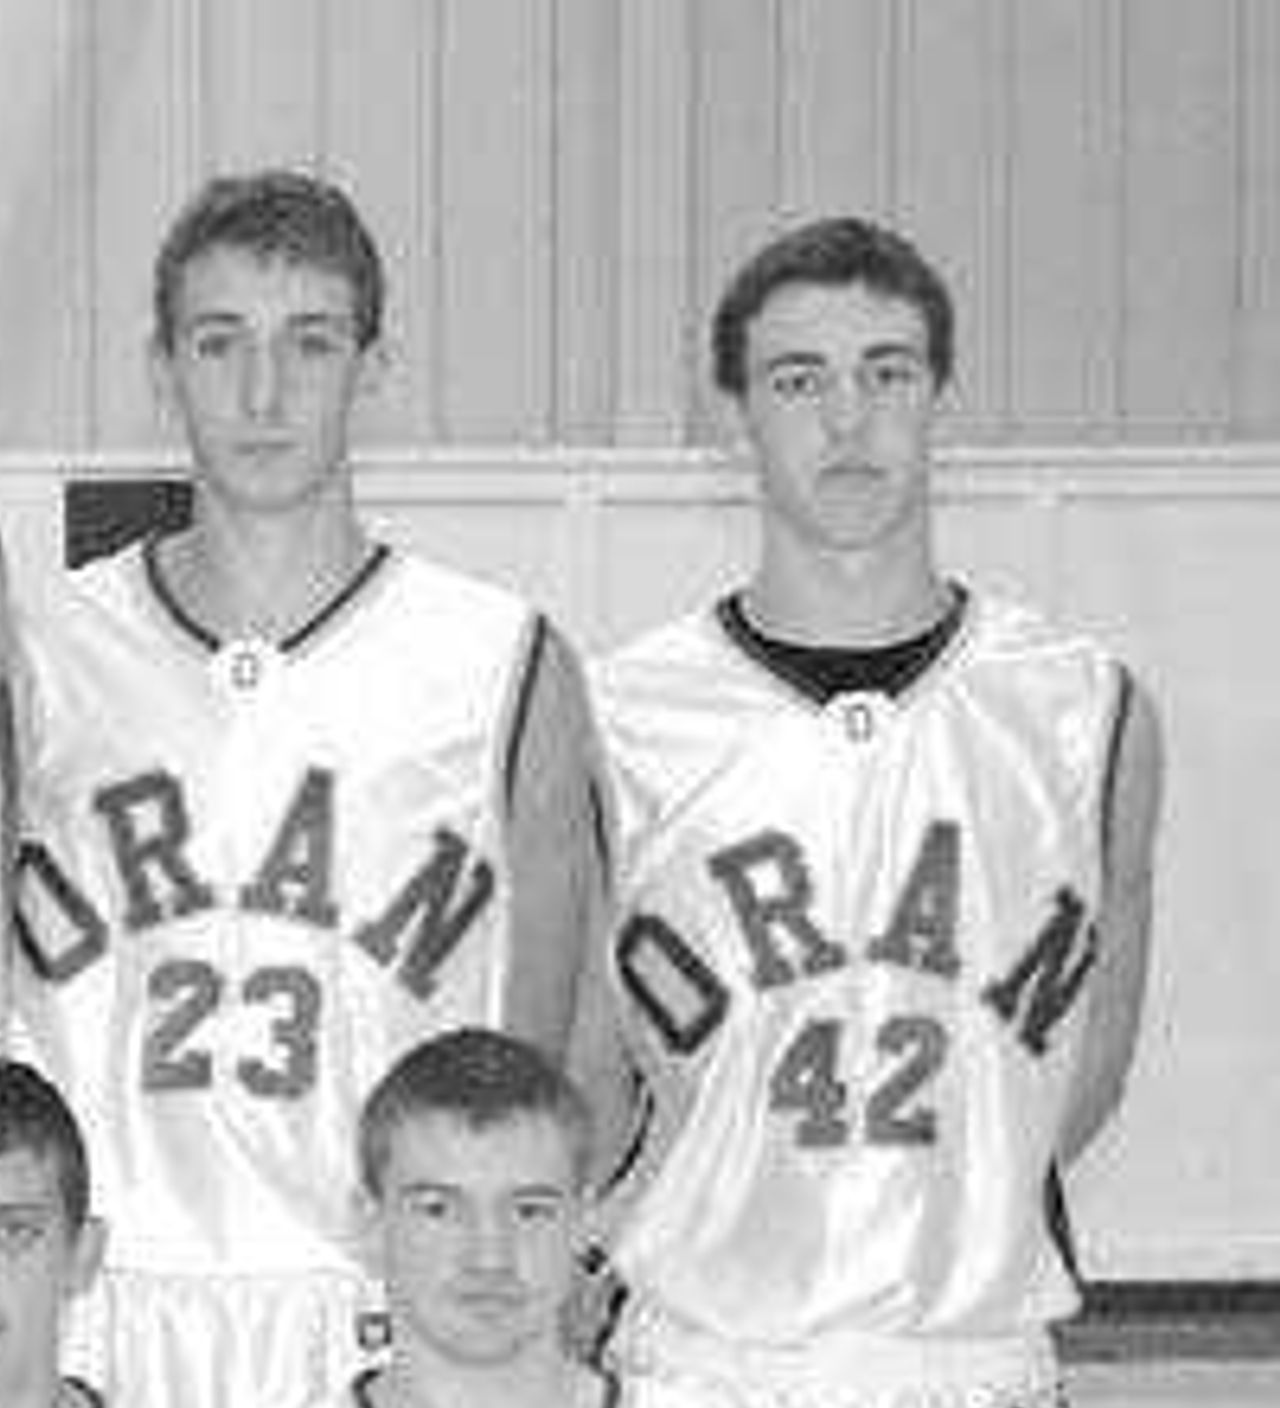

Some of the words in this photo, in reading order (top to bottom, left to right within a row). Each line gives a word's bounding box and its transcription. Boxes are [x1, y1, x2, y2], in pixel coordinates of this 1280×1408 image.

[14, 769, 494, 1001] ORAN
[615, 820, 1097, 1058] ORAN
[140, 959, 322, 1097] 23
[769, 1015, 948, 1148] 42
